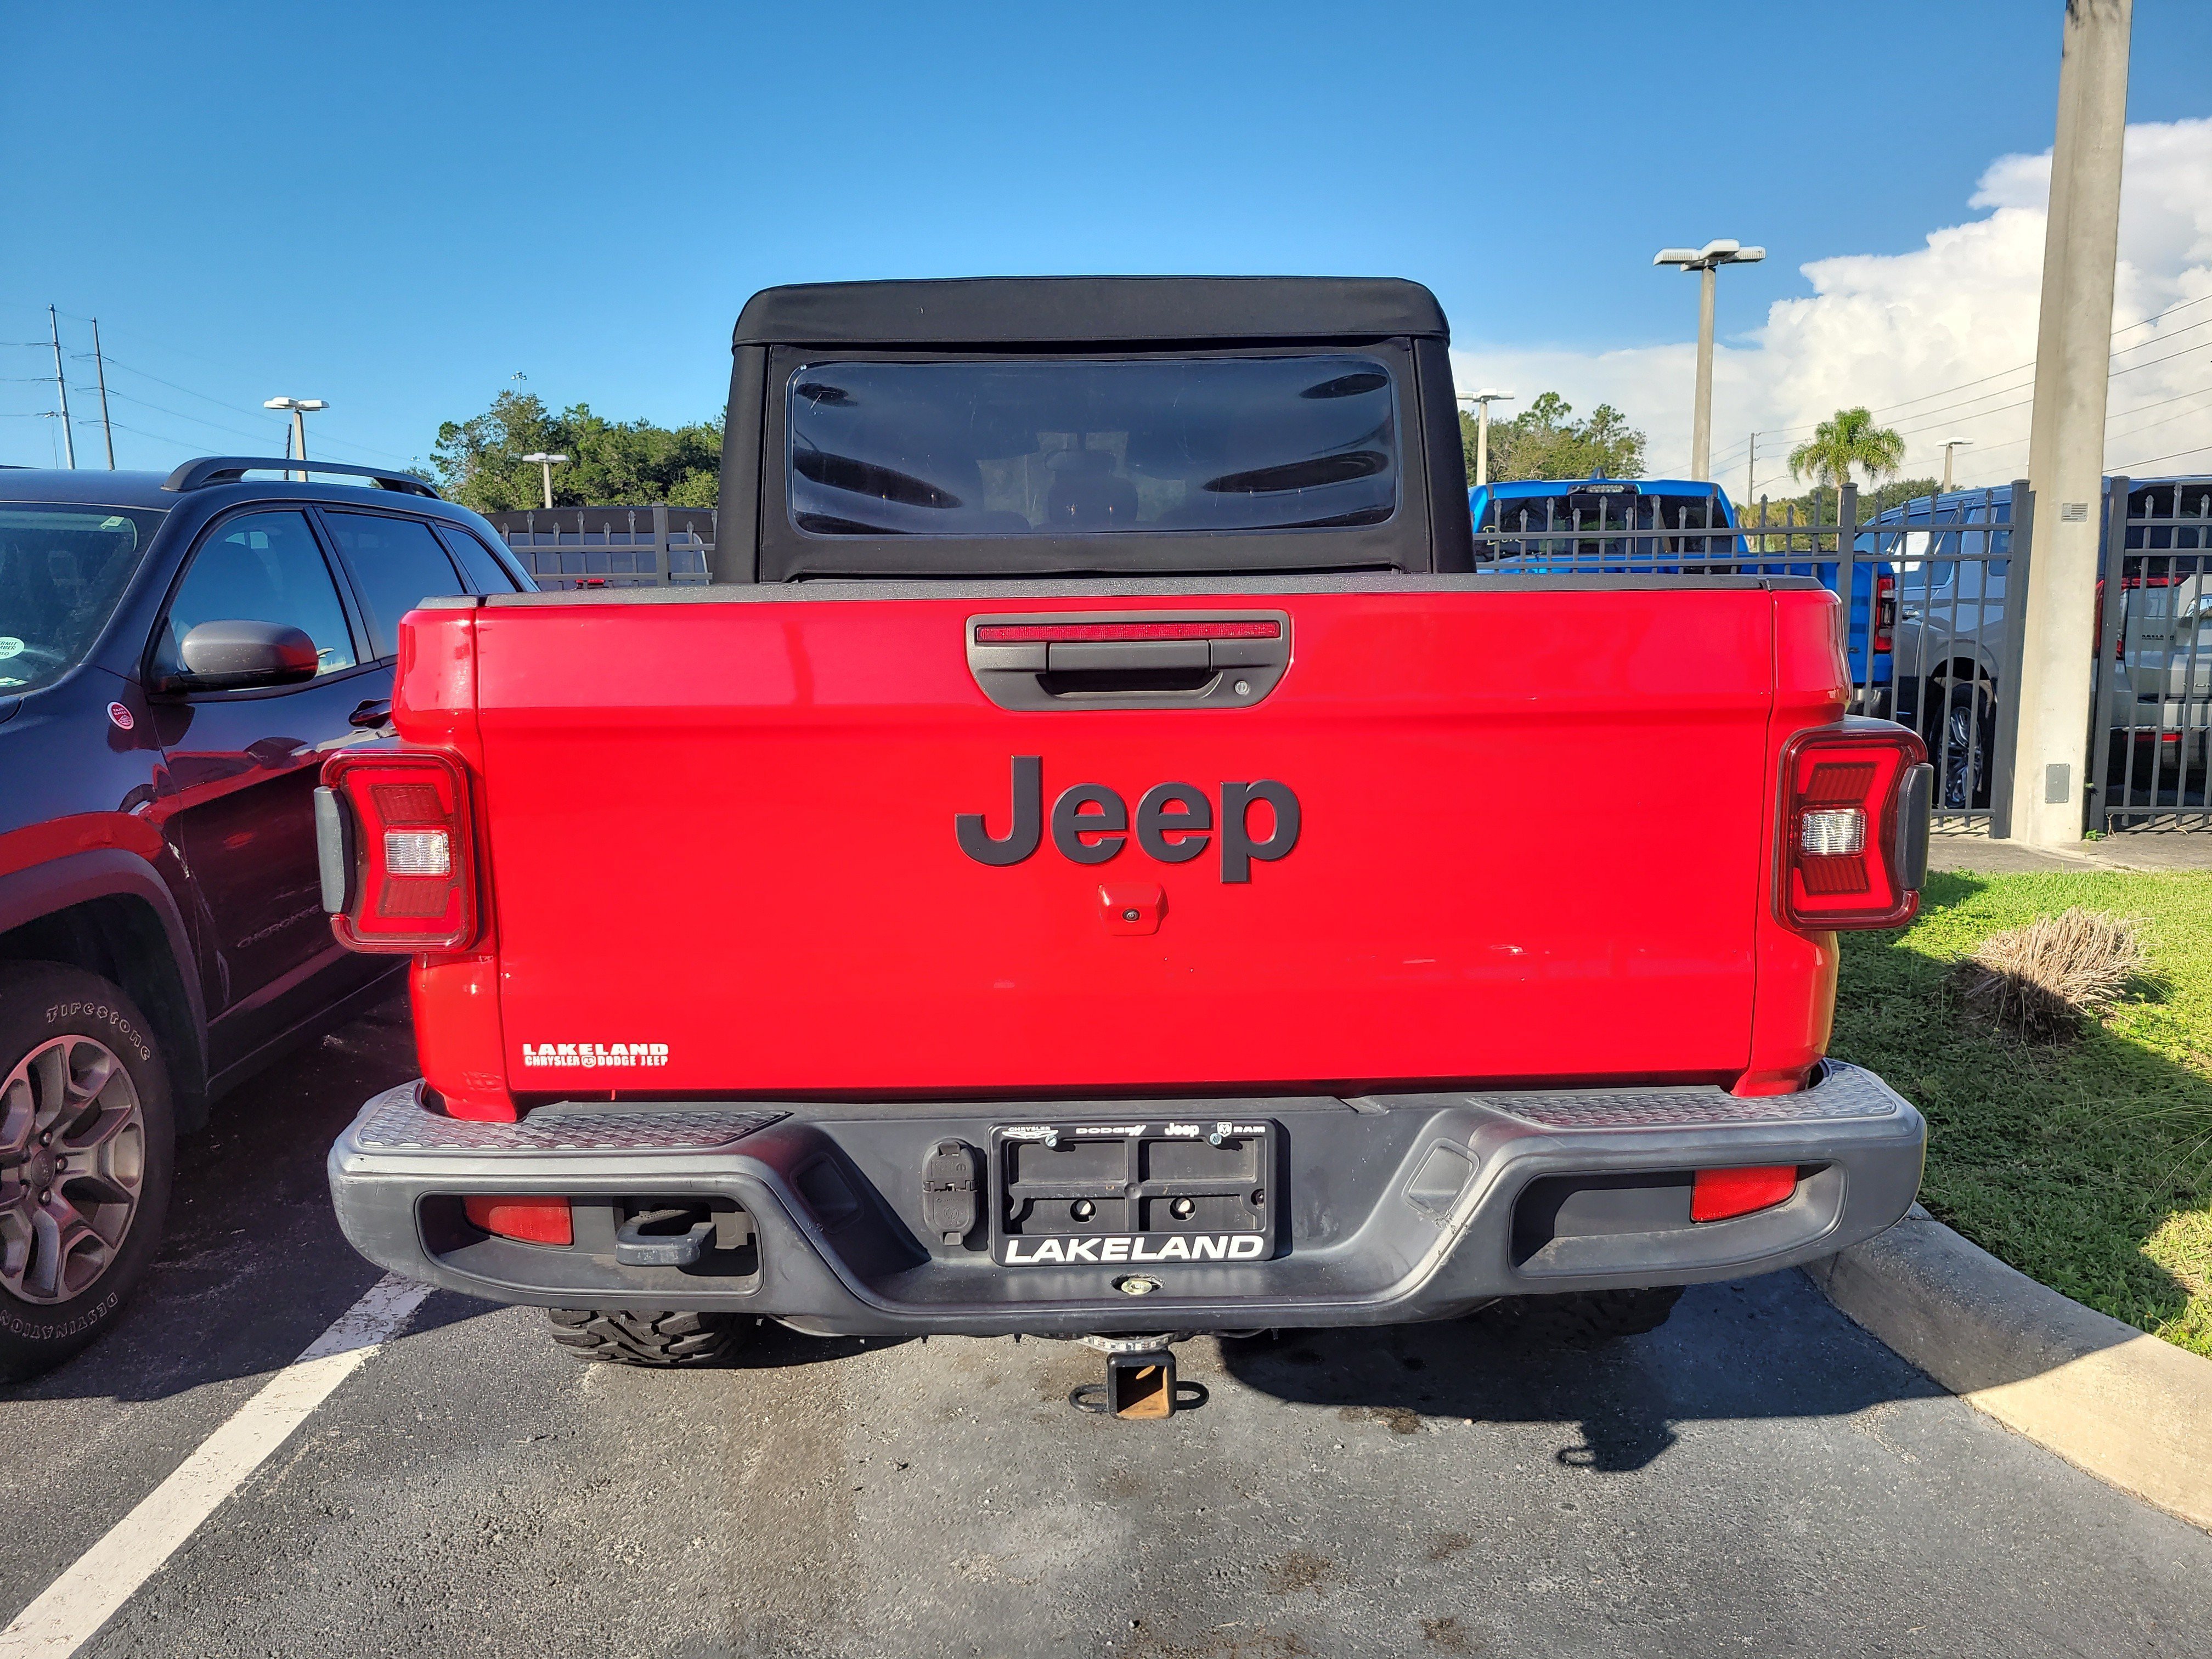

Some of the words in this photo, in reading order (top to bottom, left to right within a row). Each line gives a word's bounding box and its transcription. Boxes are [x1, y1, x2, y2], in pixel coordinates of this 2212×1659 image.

[955, 754, 1301, 884] Jeep
[46, 1002, 151, 1061] Firestone
[523, 1043, 669, 1056] LAKELAND
[525, 1056, 580, 1066] CHRYSLER
[597, 1056, 636, 1066] DODGE
[641, 1056, 668, 1066] JEEP
[1164, 1122, 1200, 1137] Jeep
[1005, 1235, 1264, 1263] LAKELAND
[0, 1292, 119, 1339] DESTINATION
